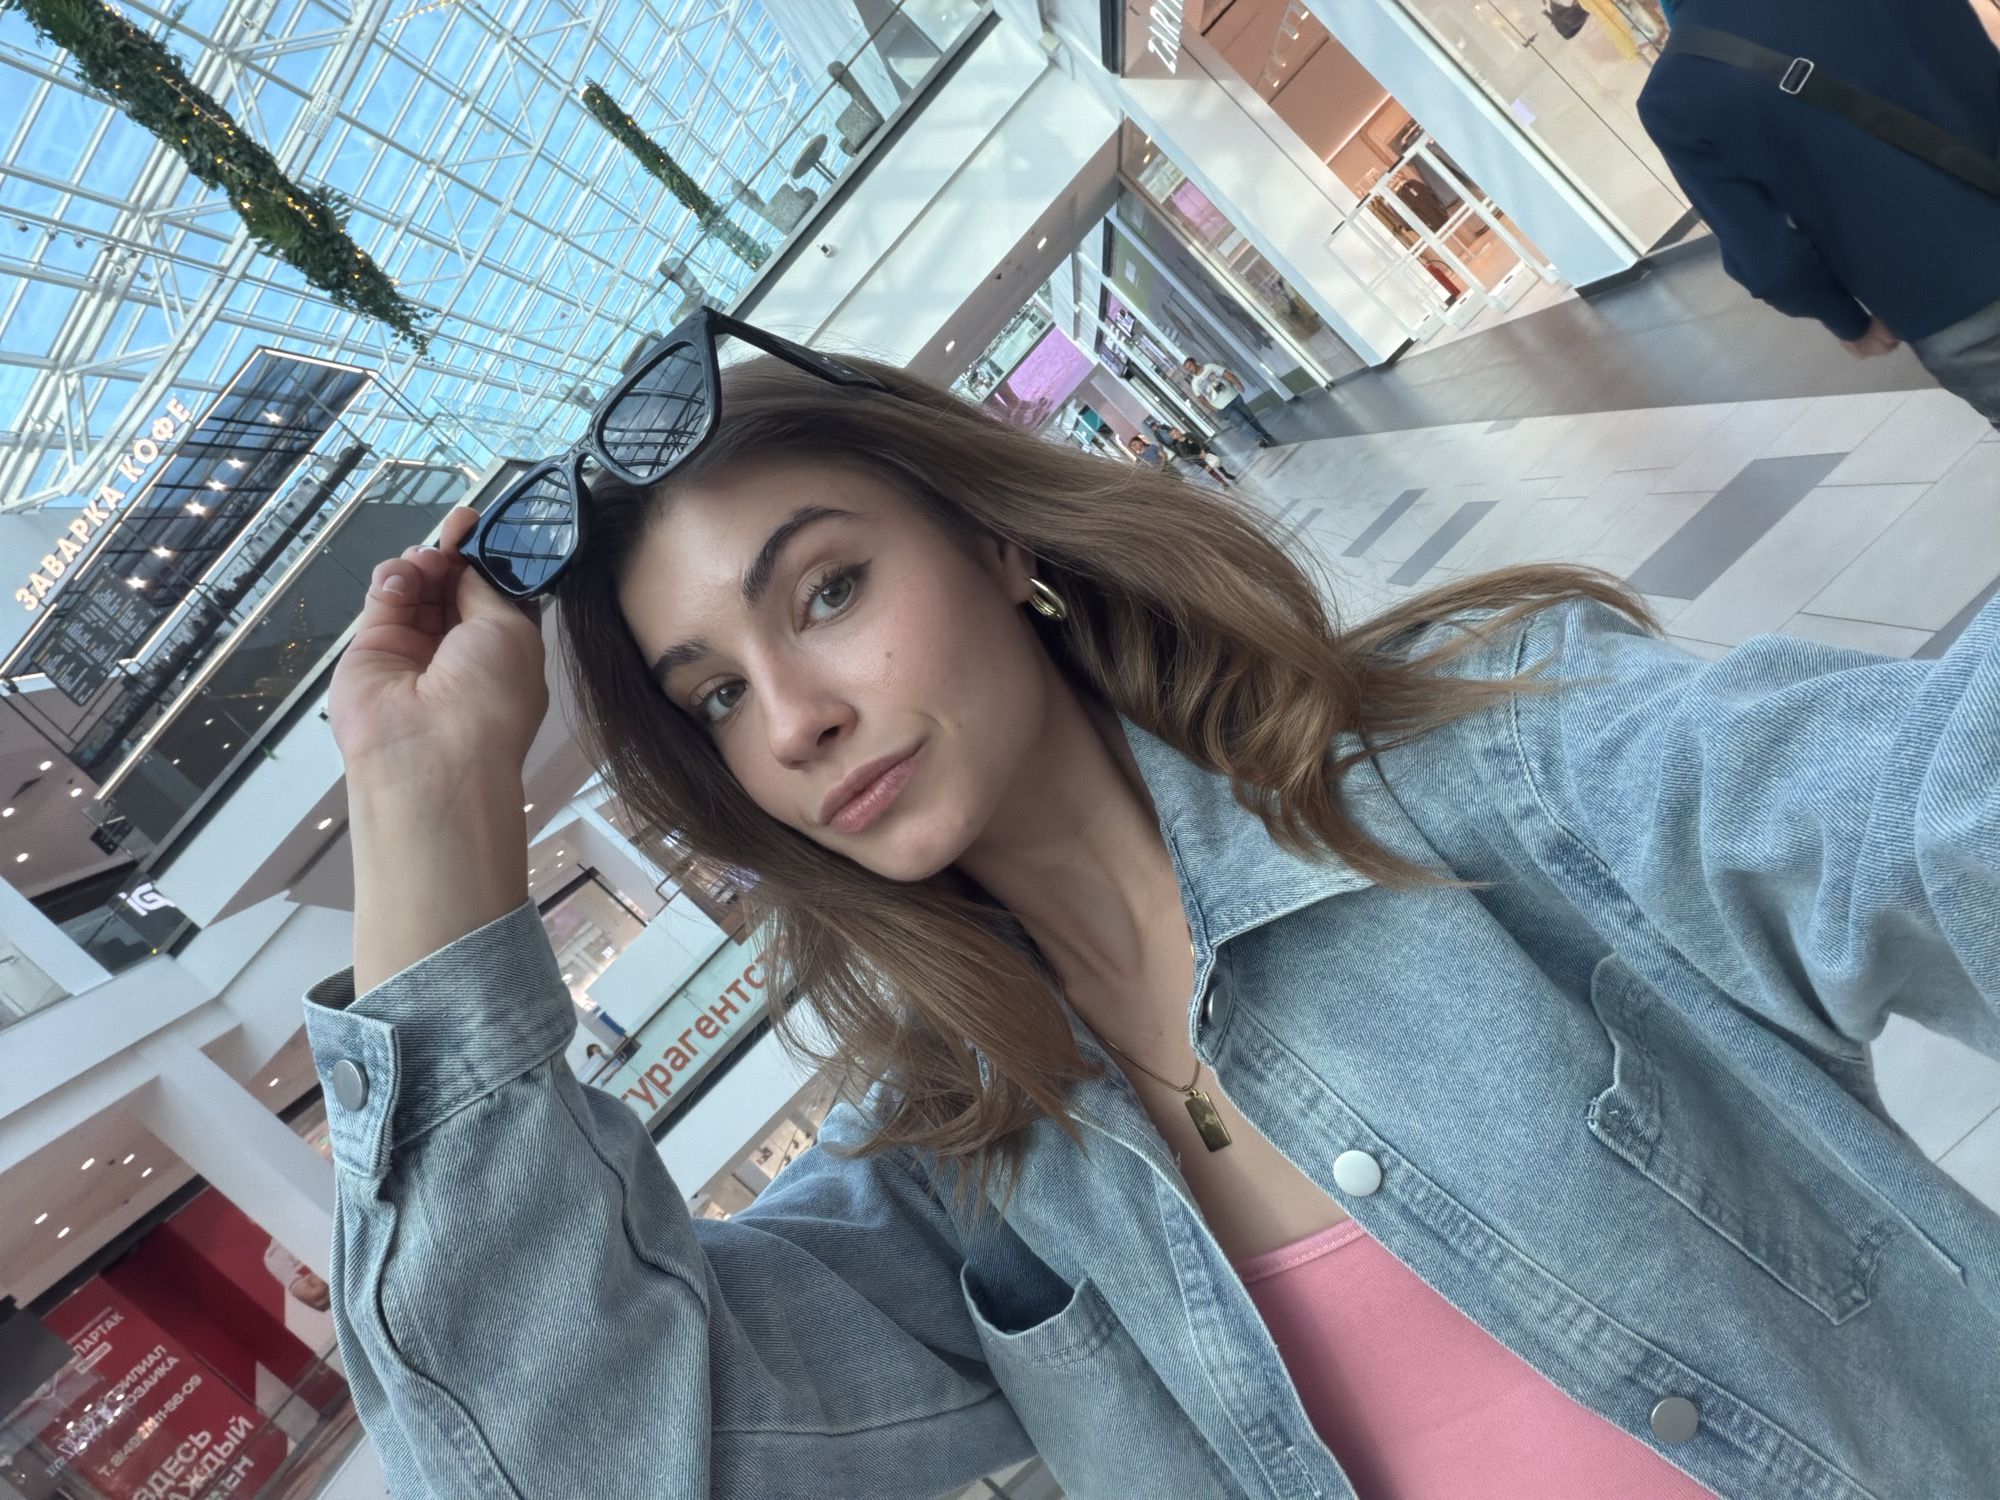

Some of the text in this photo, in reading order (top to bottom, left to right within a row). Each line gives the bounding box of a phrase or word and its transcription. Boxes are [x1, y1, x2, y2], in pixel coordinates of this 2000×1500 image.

[1147, 0, 1183, 74] ZARI
[15, 485, 126, 612] ЗАВАРКА
[117, 397, 192, 483] КОФЕ
[72, 1312, 125, 1357] ПАРТАК
[167, 1415, 255, 1500] АЖДЫЙ
